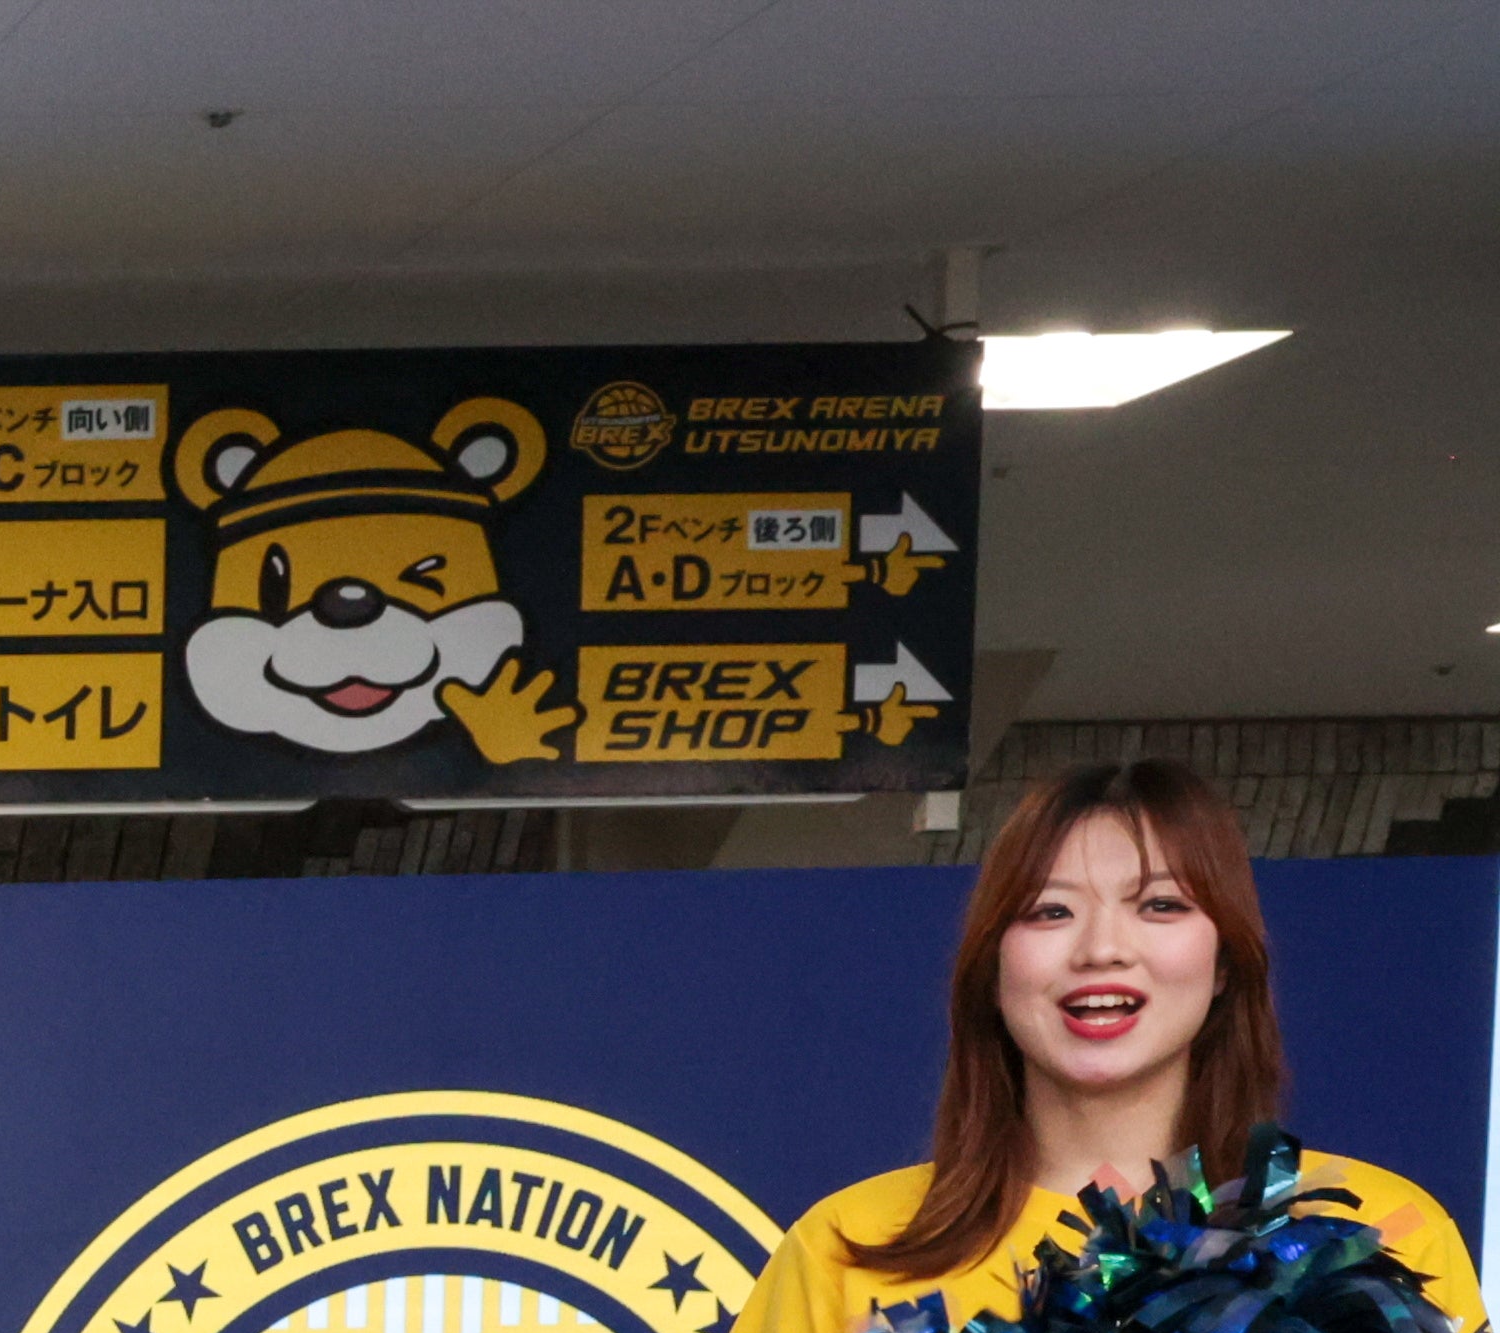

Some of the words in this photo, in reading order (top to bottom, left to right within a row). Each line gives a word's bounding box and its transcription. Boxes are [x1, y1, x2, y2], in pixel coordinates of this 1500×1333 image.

[67, 405, 151, 433] 向い側
[687, 398, 801, 421] BREX
[809, 396, 945, 420] ARENA
[576, 422, 670, 449] BREX
[684, 428, 942, 452] UTSUNOMIYA
[603, 505, 743, 544] 2Fベンチ
[753, 515, 836, 544] 後ろ側
[603, 660, 820, 702] BREX
[605, 709, 810, 751] SHOP
[232, 1168, 403, 1275] BREX
[426, 1164, 645, 1271] NATION
